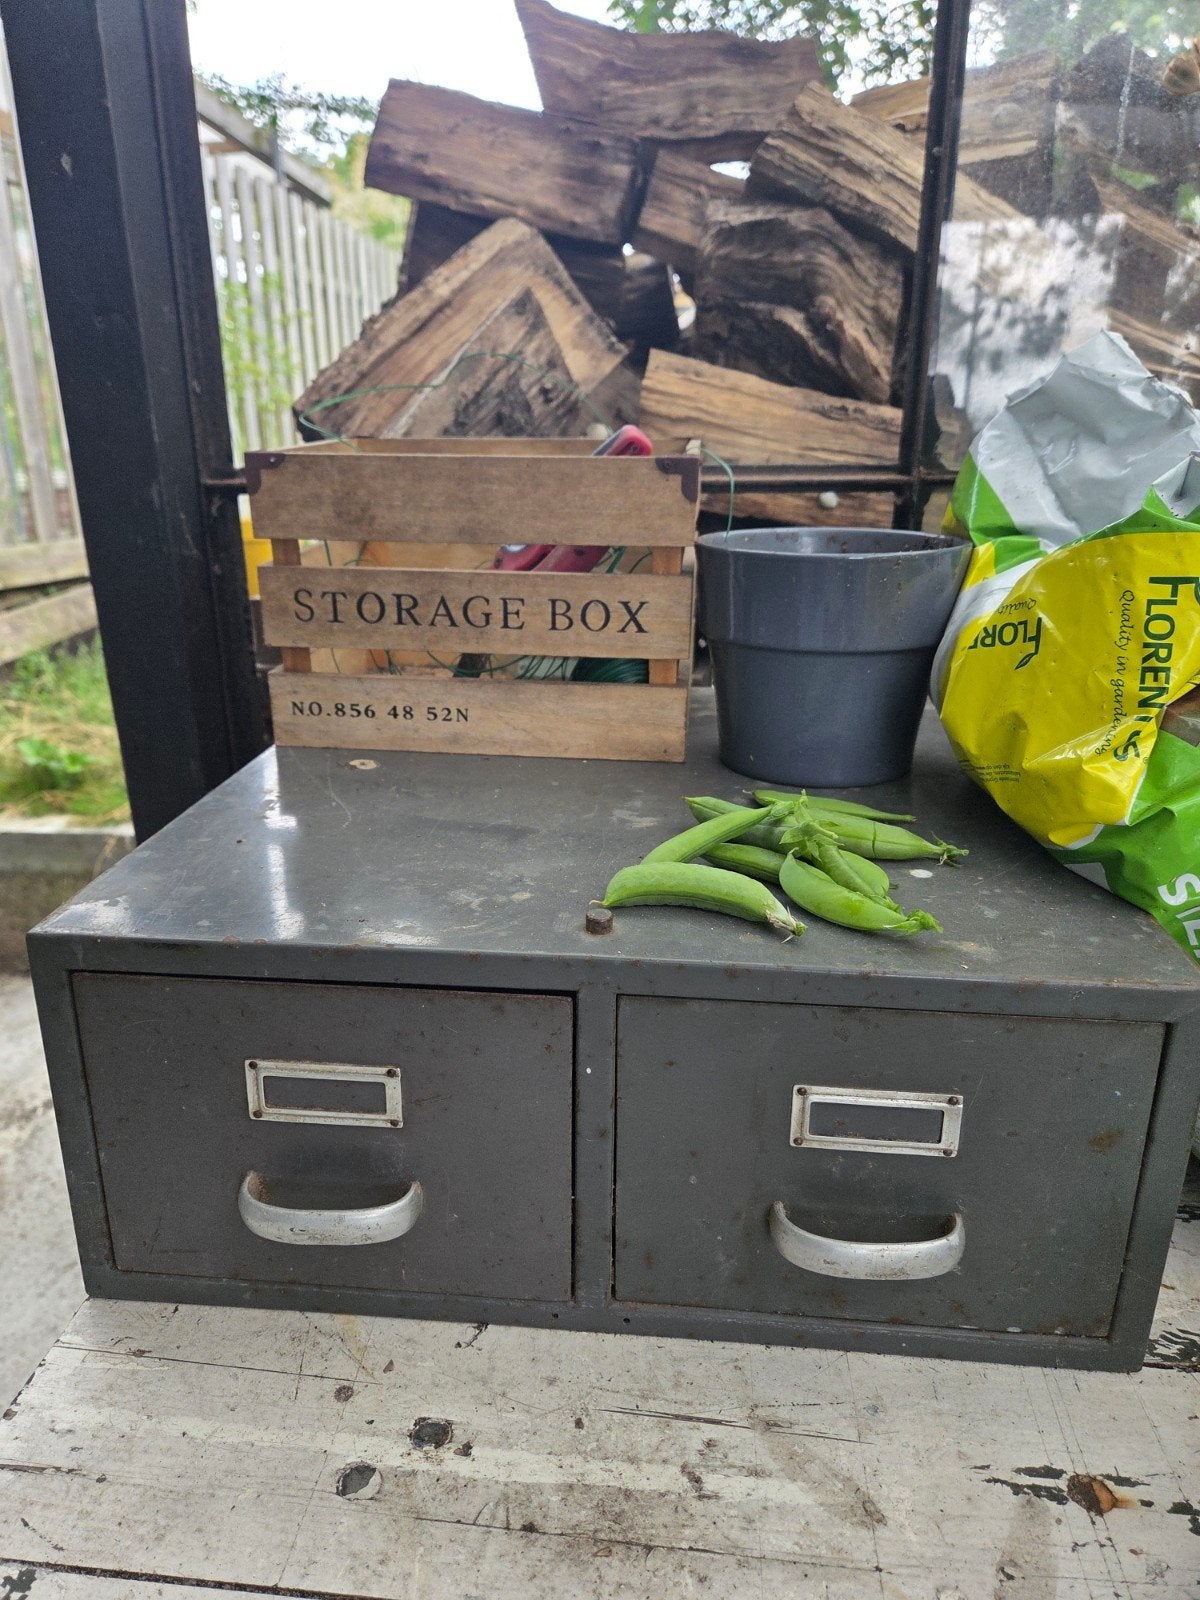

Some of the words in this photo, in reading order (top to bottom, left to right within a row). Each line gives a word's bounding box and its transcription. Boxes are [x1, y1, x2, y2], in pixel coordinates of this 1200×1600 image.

[293, 588, 526, 631] STORAGE
[547, 598, 650, 634] BOX
[995, 598, 1037, 615] Qualit
[1114, 589, 1135, 651] Quality
[1116, 655, 1130, 676] in
[291, 701, 376, 719] NO.856
[387, 705, 414, 721] 48
[426, 706, 469, 722] 52N
[1095, 678, 1128, 756] gardening
